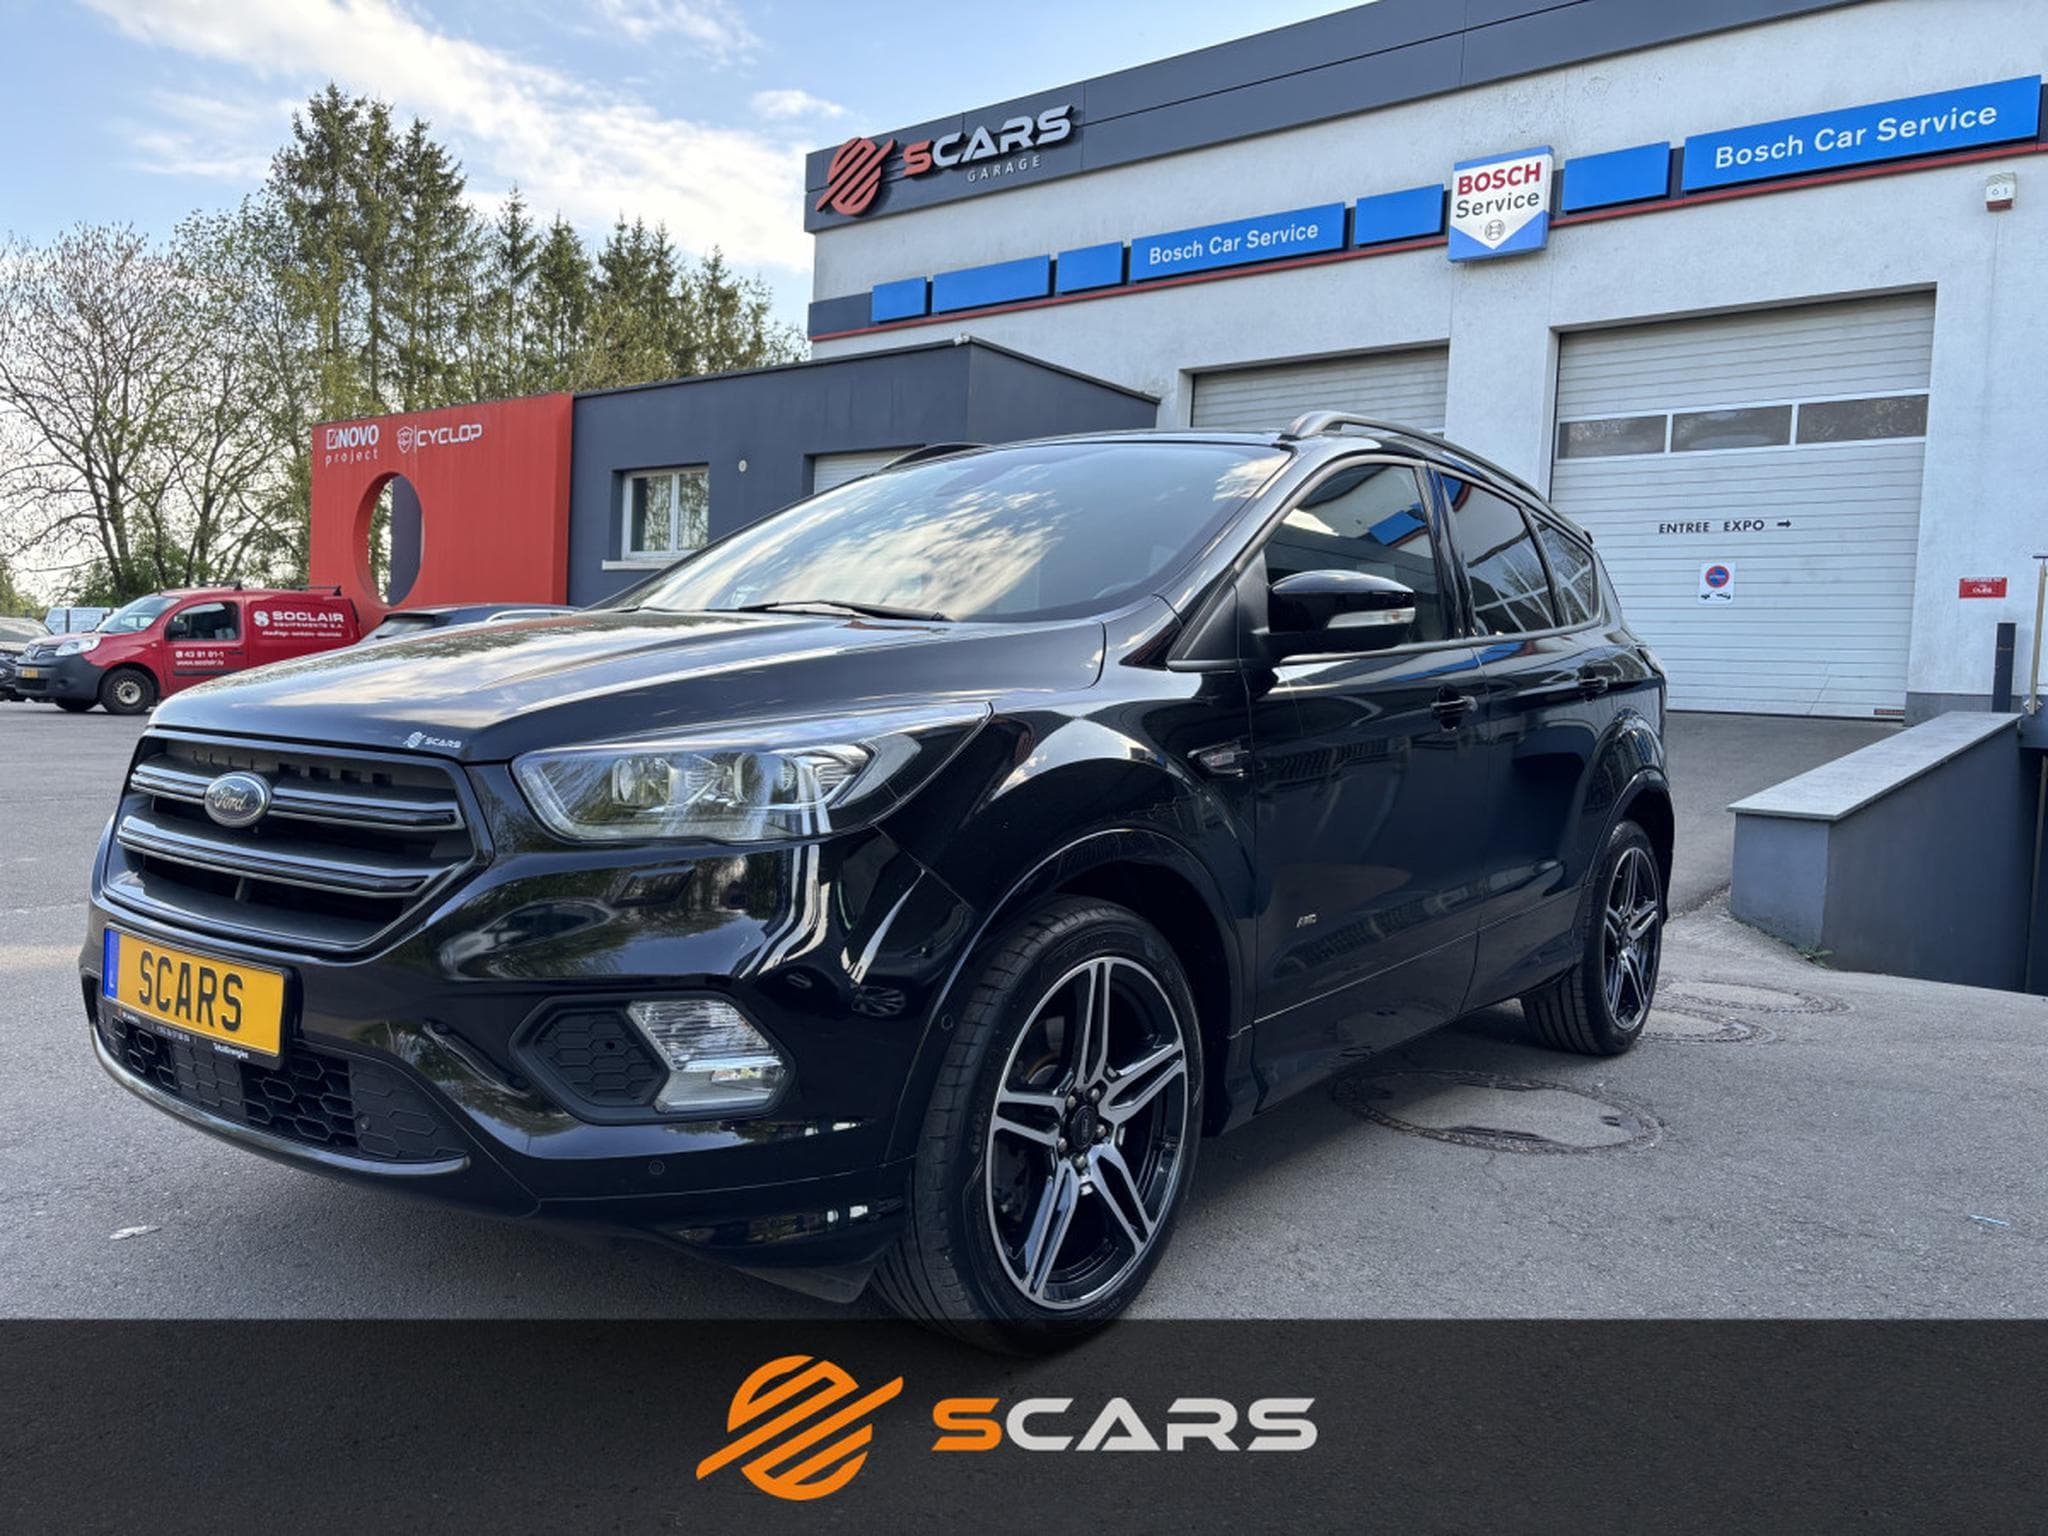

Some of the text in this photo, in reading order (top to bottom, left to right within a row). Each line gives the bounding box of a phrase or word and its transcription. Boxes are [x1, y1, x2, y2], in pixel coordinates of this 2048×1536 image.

[903, 104, 1072, 177] SCARS
[1714, 105, 1998, 170] Bosch Car Service
[967, 154, 1042, 183] GARAGE
[1457, 161, 1542, 196] BOSCH
[1455, 191, 1540, 219] Service
[1149, 222, 1319, 265] Bosch Car Service
[416, 423, 483, 448] CYCLOP
[324, 447, 379, 469] project
[1658, 519, 1765, 535] ENTREE EXPO
[271, 610, 345, 623] SOCLAIR
[424, 736, 462, 749] SCARS
[212, 784, 252, 813] Ford
[139, 950, 243, 1032] SCARS
